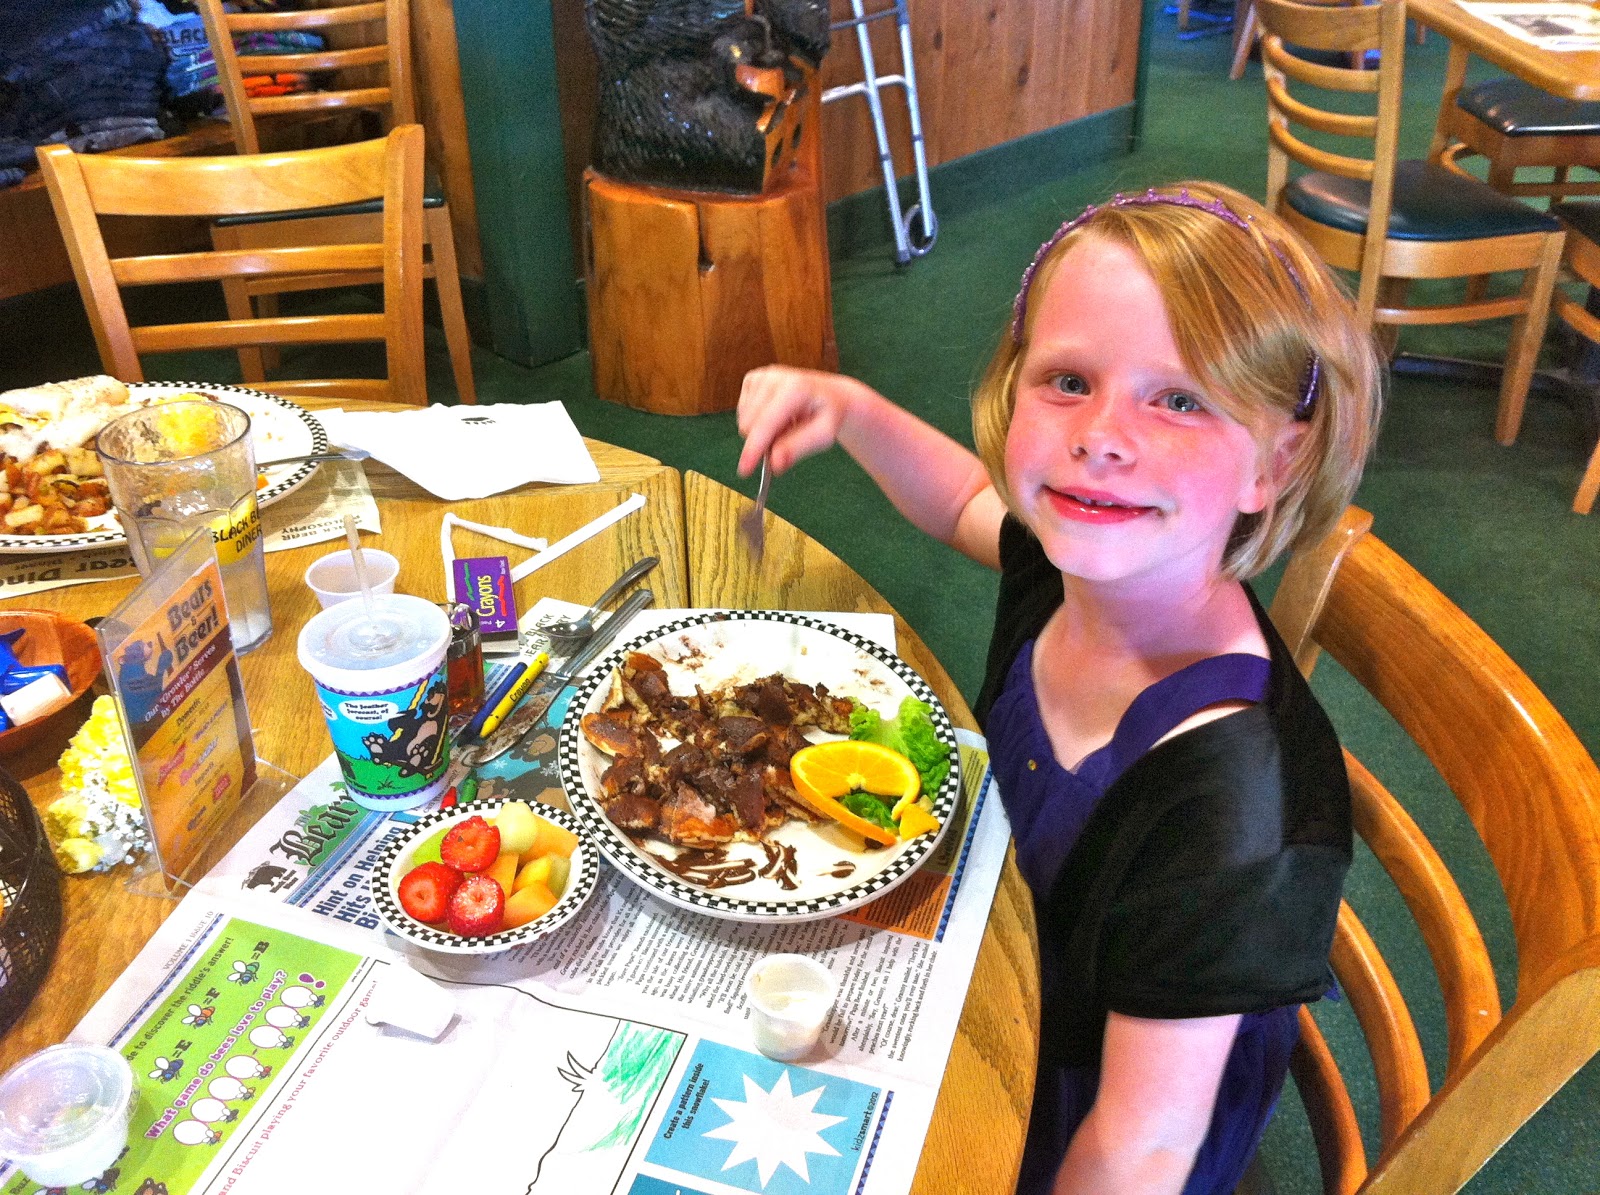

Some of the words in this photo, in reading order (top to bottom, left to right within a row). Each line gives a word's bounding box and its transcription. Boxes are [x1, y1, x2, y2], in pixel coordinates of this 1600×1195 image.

[281, 514, 360, 534] PILOSOPHY
[236, 527, 262, 554] DINER
[0, 568, 61, 587] Din
[166, 579, 213, 633] Bears
[476, 575, 499, 617] Crayons
[174, 606, 219, 663] Beer!
[510, 678, 531, 702] Crayon
[144, 703, 160, 722] Our
[312, 889, 348, 916] Hint
[342, 871, 364, 889] on
[333, 895, 371, 923] Hits
[163, 942, 188, 970] VOLUME
[886, 958, 895, 969] help
[840, 966, 852, 986] thankful
[845, 982, 856, 1002] prepare
[852, 968, 862, 981] today
[860, 951, 868, 959] the
[851, 1027, 860, 1041] After
[860, 999, 870, 1017] minute
[875, 956, 885, 973] Biscuit
[882, 935, 894, 954] inquired
[920, 978, 928, 990] forth
[134, 1040, 147, 1050] to
[144, 1008, 175, 1040] discover
[171, 995, 187, 1008] the
[184, 967, 211, 995] riddle's
[208, 936, 234, 967] answer!
[849, 1003, 858, 1015] Papa
[854, 991, 862, 1003] Bear
[887, 1050, 895, 1059] the
[892, 1026, 902, 1048] sweetest
[899, 1013, 907, 1025] ones
[904, 997, 912, 1011] you'll
[916, 959, 924, 969] She
[921, 943, 929, 958] smiled
[895, 984, 907, 1002] Granny
[912, 1001, 921, 1012] back
[868, 1032, 880, 1054] peaches
[876, 1020, 884, 1032] next
[908, 1013, 919, 1032] rocking
[145, 1108, 177, 1139] What
[174, 1078, 202, 1107] game
[199, 1062, 214, 1076] do
[210, 1036, 235, 1061] bees
[232, 1013, 254, 1035] love
[250, 1001, 264, 1013] to
[262, 970, 287, 1000] play?
[218, 1177, 236, 1195] and
[232, 1141, 262, 1175] Biscuit
[260, 1104, 292, 1140] playing
[287, 1080, 306, 1102] your
[303, 1042, 334, 1077] favorite
[332, 1008, 361, 1040] outdoor
[664, 1116, 680, 1139] Create
[679, 1084, 695, 1110] pattern
[689, 1063, 704, 1083] inside
[682, 1116, 693, 1129] this
[690, 1079, 710, 1114] snowflake!
[851, 1111, 872, 1151] kidzsmart
